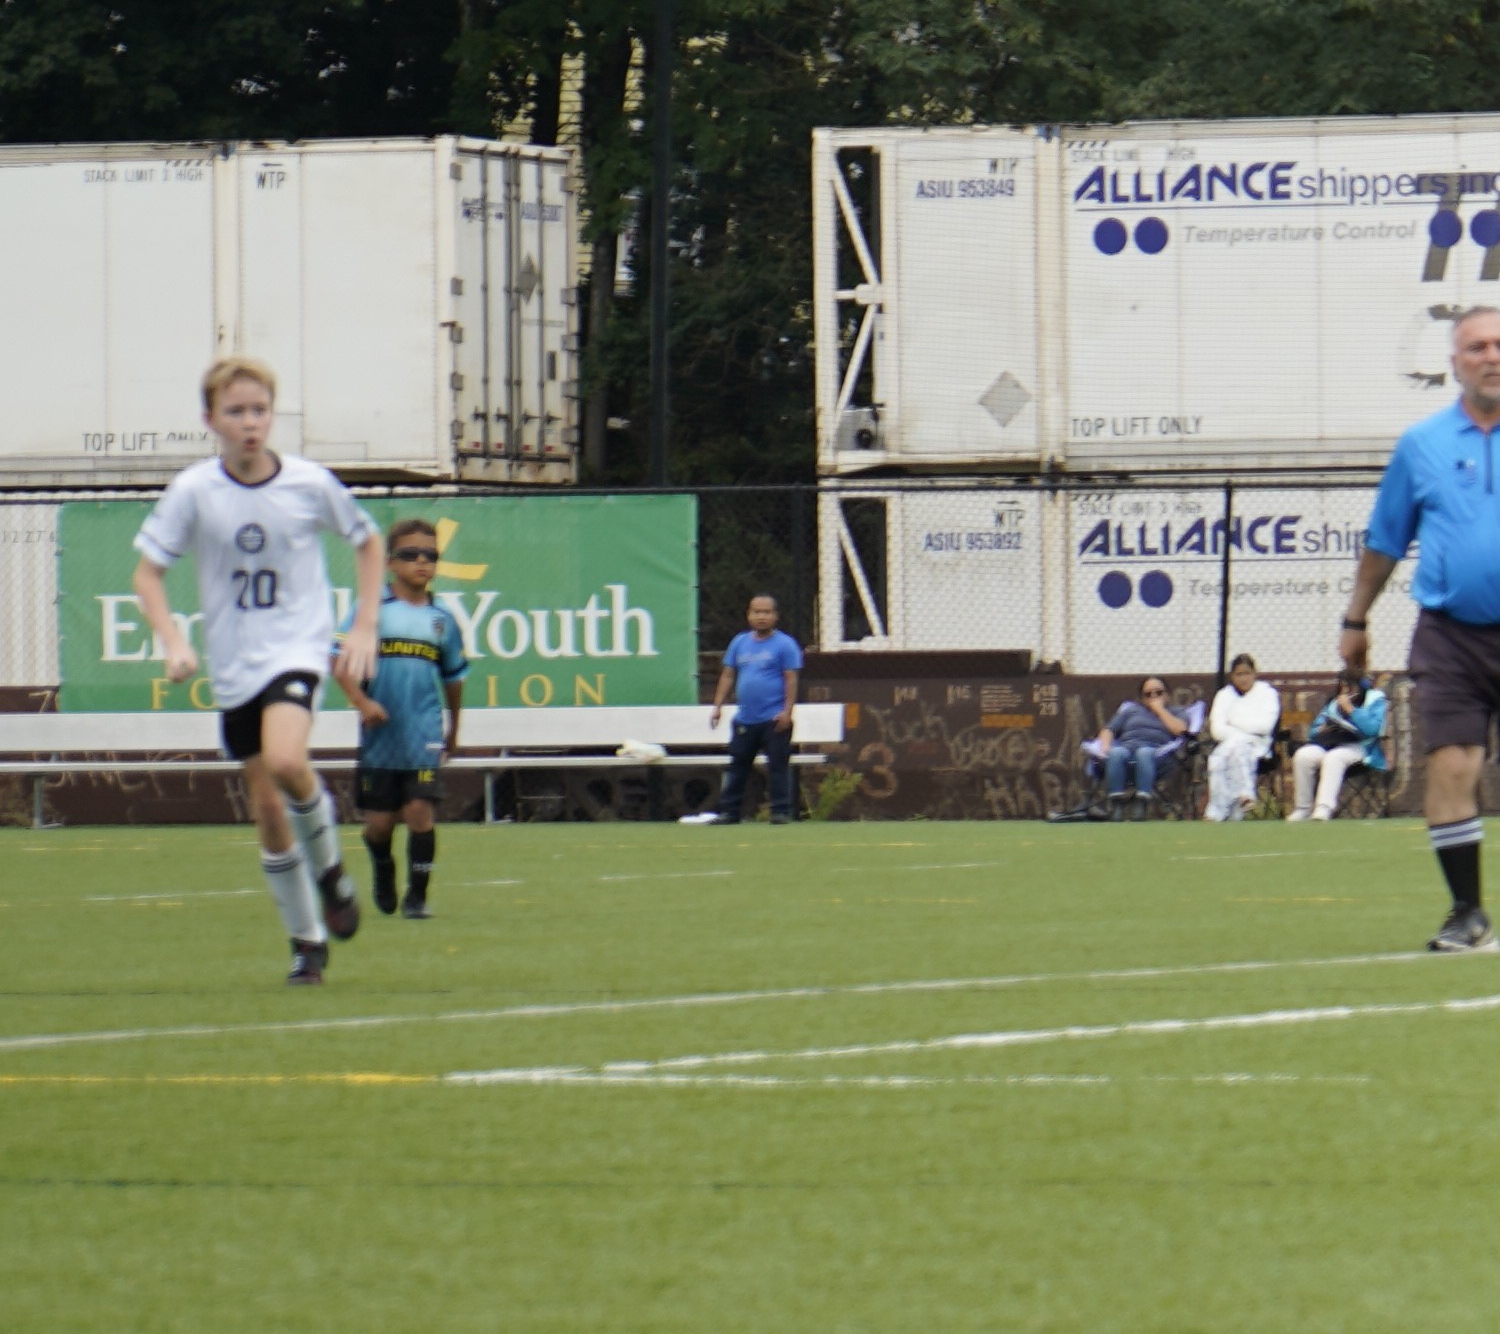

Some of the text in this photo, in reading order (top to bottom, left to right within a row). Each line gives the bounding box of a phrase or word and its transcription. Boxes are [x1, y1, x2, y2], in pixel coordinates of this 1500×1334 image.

[84, 169, 116, 182] STACK
[124, 168, 153, 182] LIMIT
[176, 167, 204, 181] HIGH
[256, 170, 285, 189] WTP
[1074, 161, 1298, 204] ALLIANCE
[1299, 166, 1450, 206] shippers
[916, 180, 952, 198] ASIU
[1183, 220, 1418, 247] Temperature Control
[1072, 416, 1204, 437] TOP LIFT ONLY
[82, 433, 114, 452] TOP
[121, 432, 157, 451] LIFT
[994, 509, 1024, 527] WTP
[924, 533, 961, 551] ASIU
[1079, 516, 1302, 556] ALLIANCE
[232, 569, 277, 609] 20
[434, 584, 660, 660] Youth
